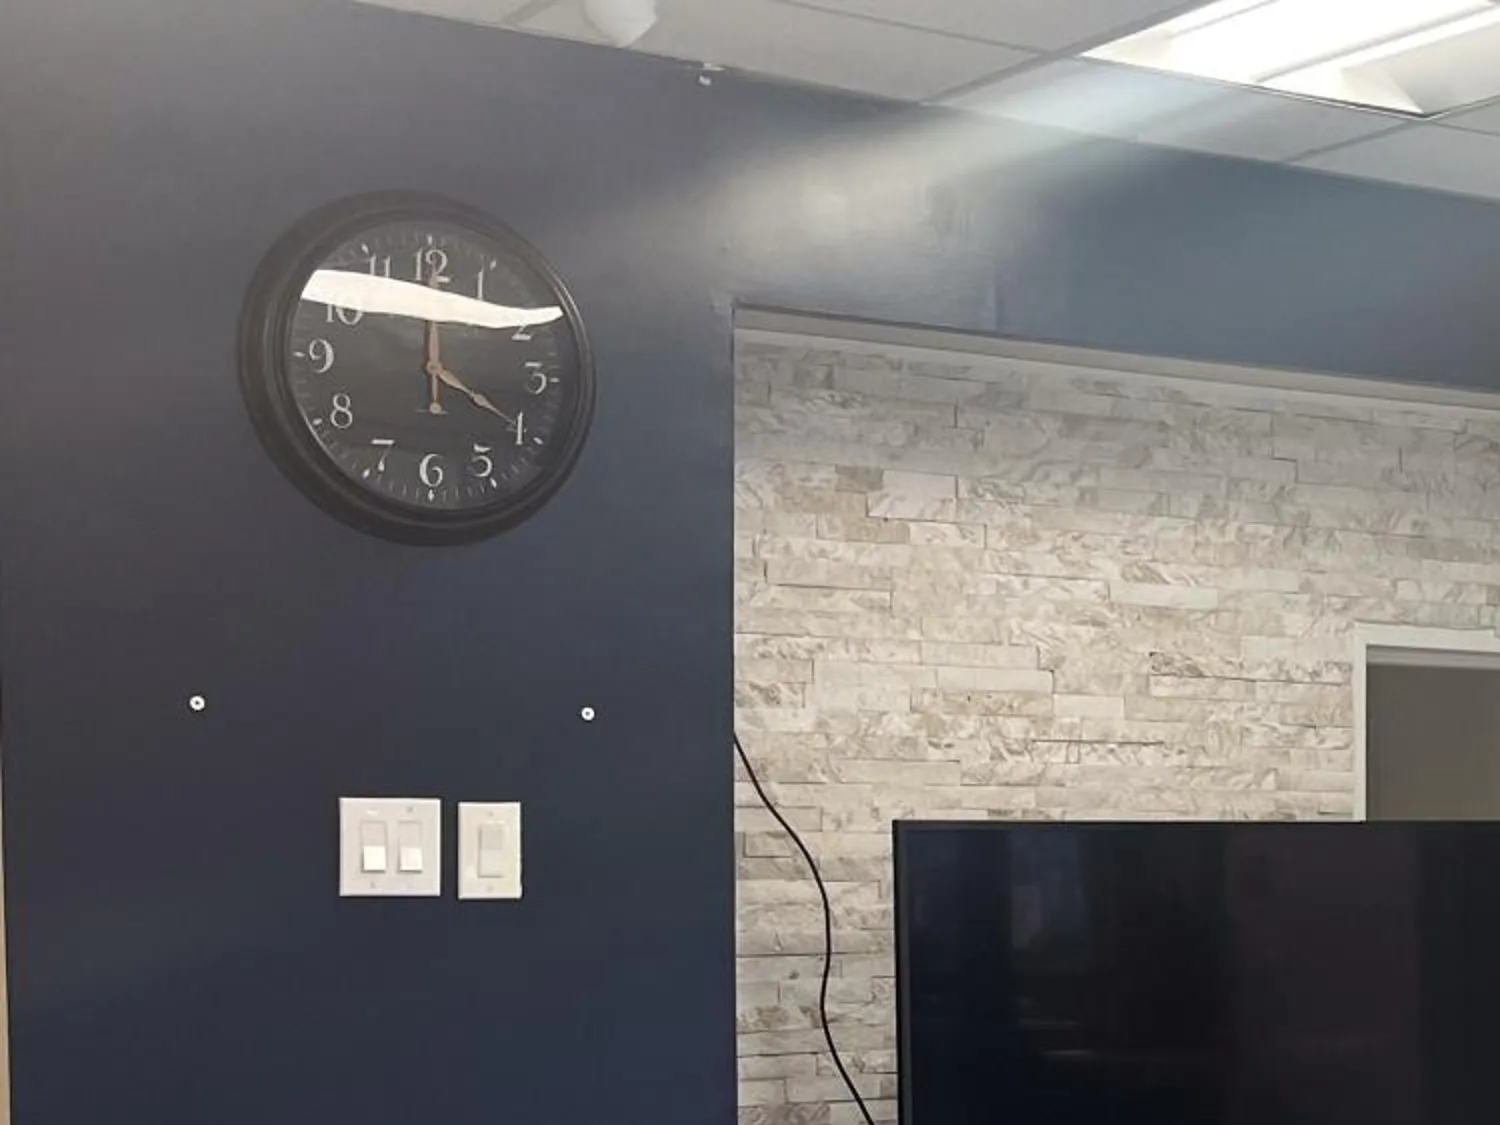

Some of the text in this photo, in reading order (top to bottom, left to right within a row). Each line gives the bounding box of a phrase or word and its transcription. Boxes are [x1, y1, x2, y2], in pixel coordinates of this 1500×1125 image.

[415, 247, 450, 284] 12
[309, 338, 335, 374] 9
[525, 361, 548, 395] 3
[330, 393, 353, 429] 8
[371, 438, 395, 472] 7
[419, 453, 444, 488] 6
[470, 443, 493, 478] 5
